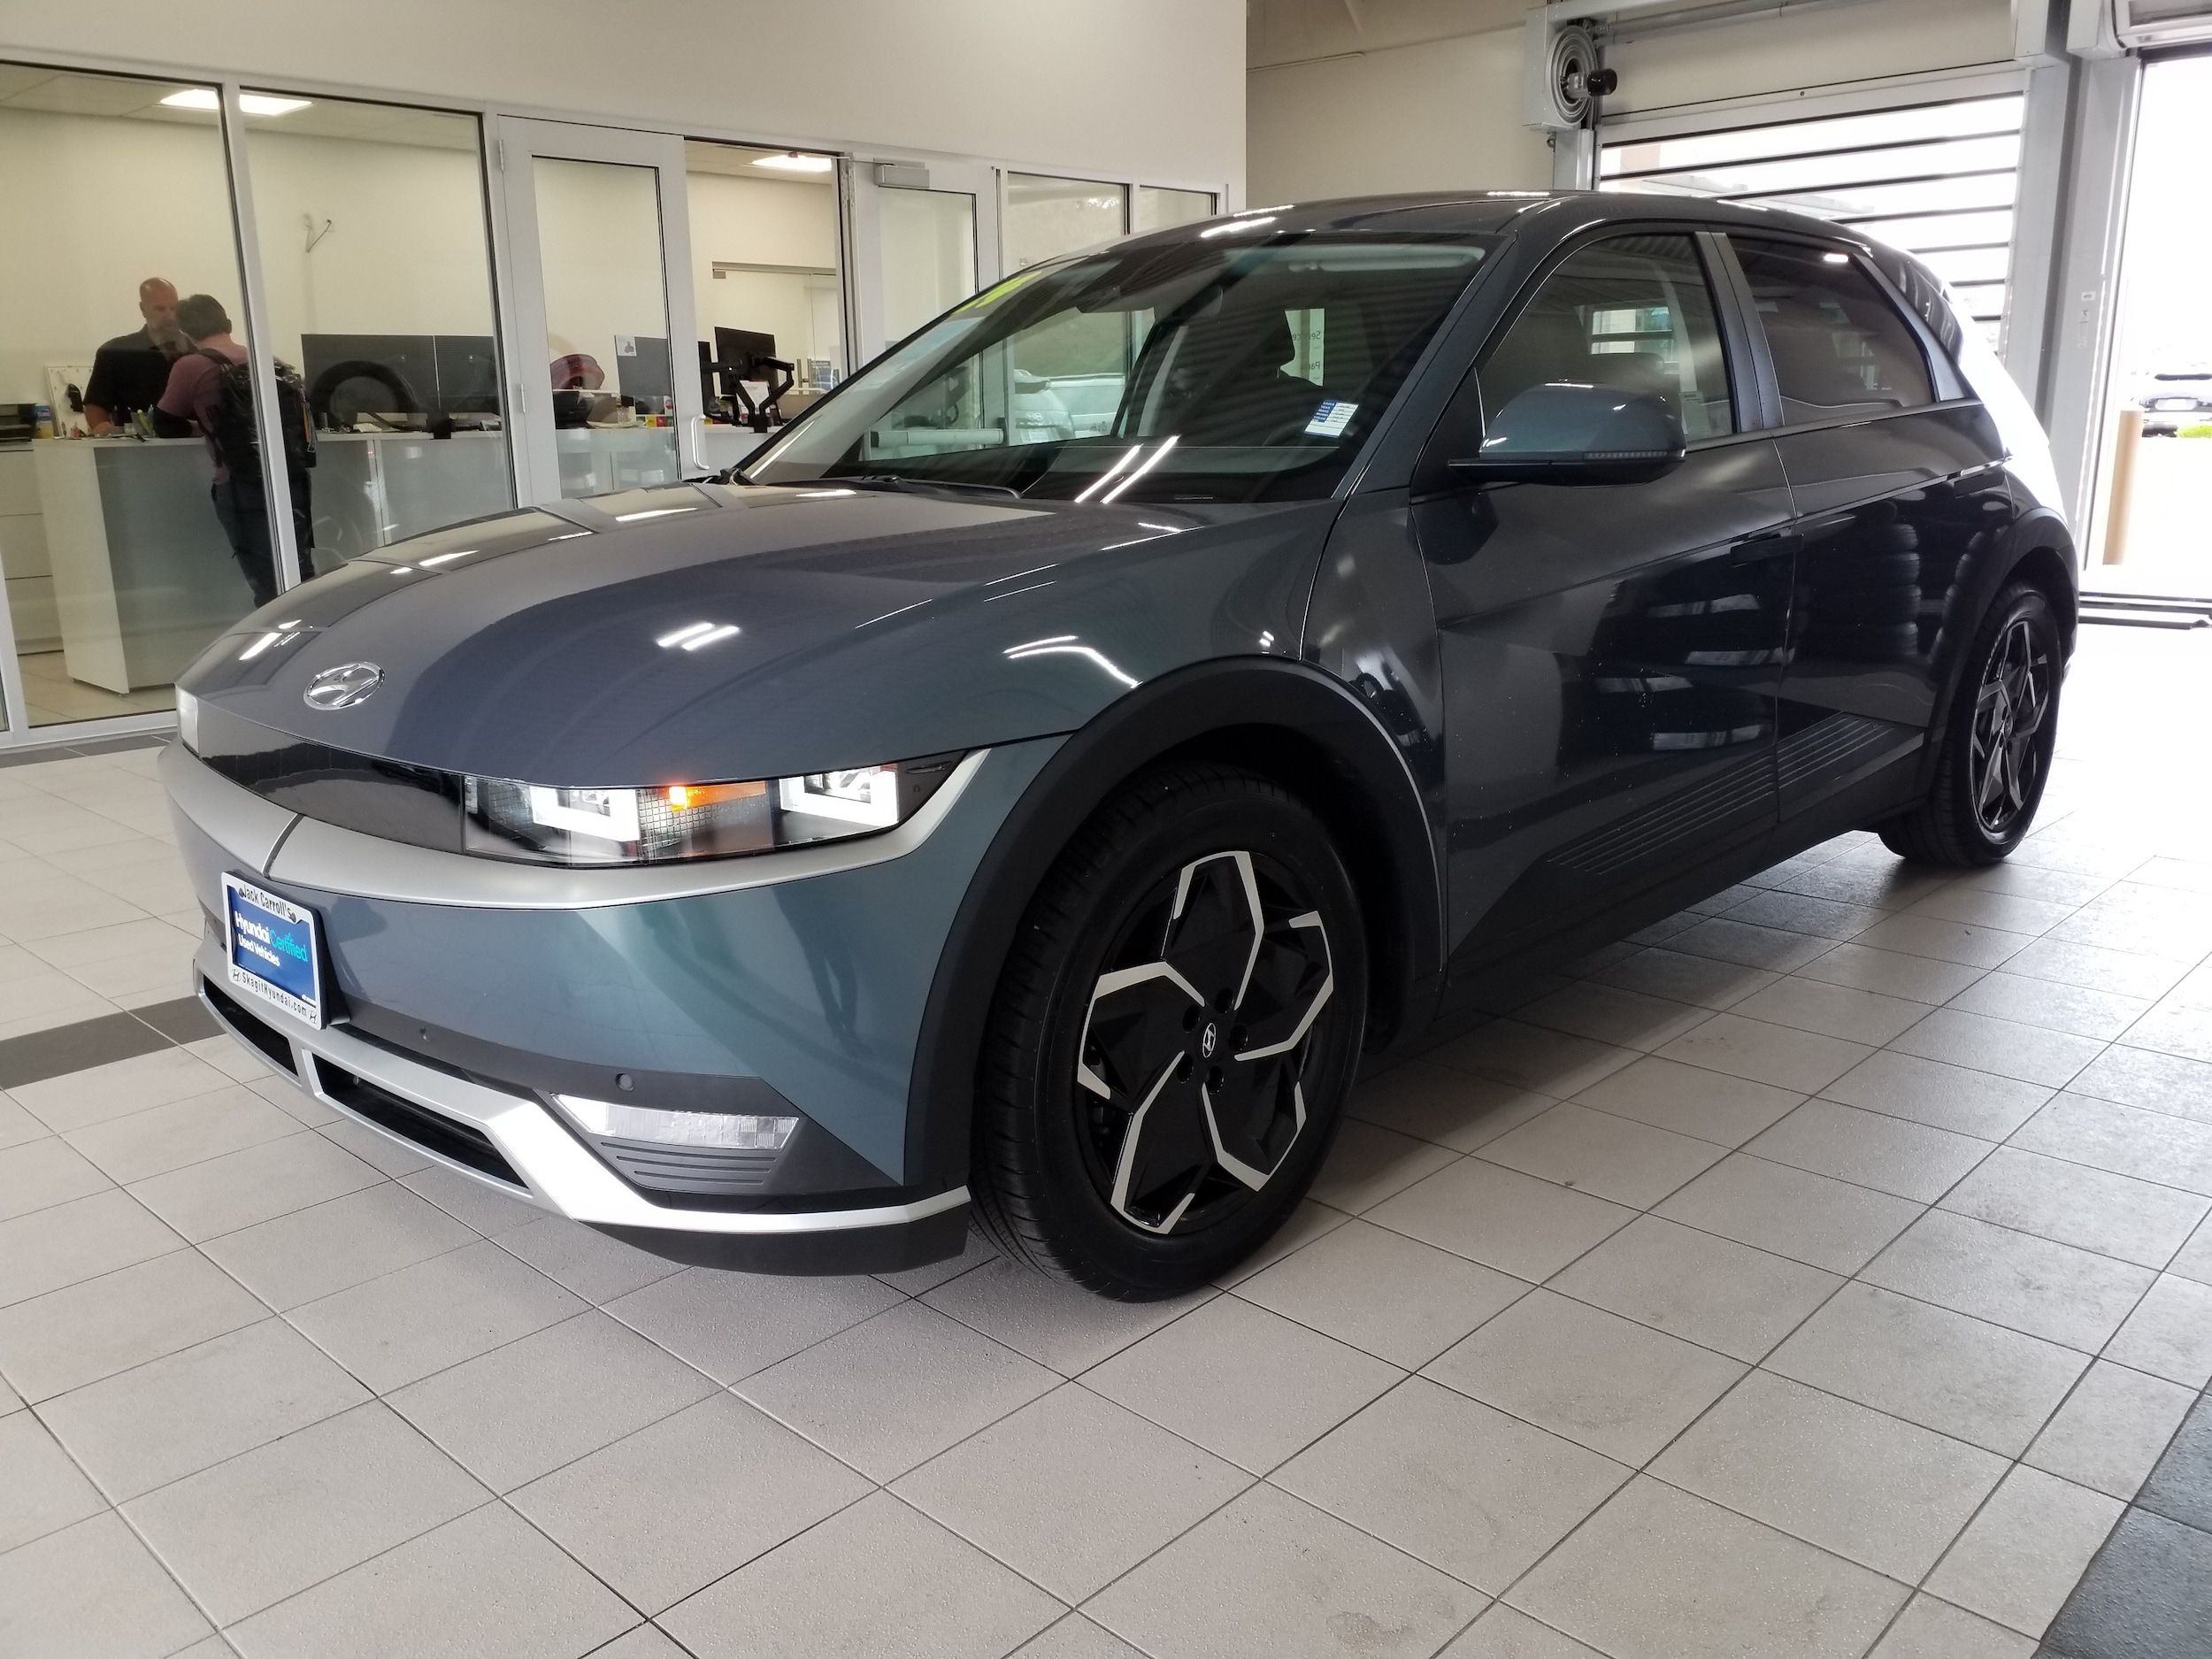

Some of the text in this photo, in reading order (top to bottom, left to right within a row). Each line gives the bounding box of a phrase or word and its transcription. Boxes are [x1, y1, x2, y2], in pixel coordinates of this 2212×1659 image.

[243, 885, 292, 919] Jack Carroll's
[238, 933, 280, 967] Used Vehicles
[242, 972, 307, 1017] SkagitHyundai.com
